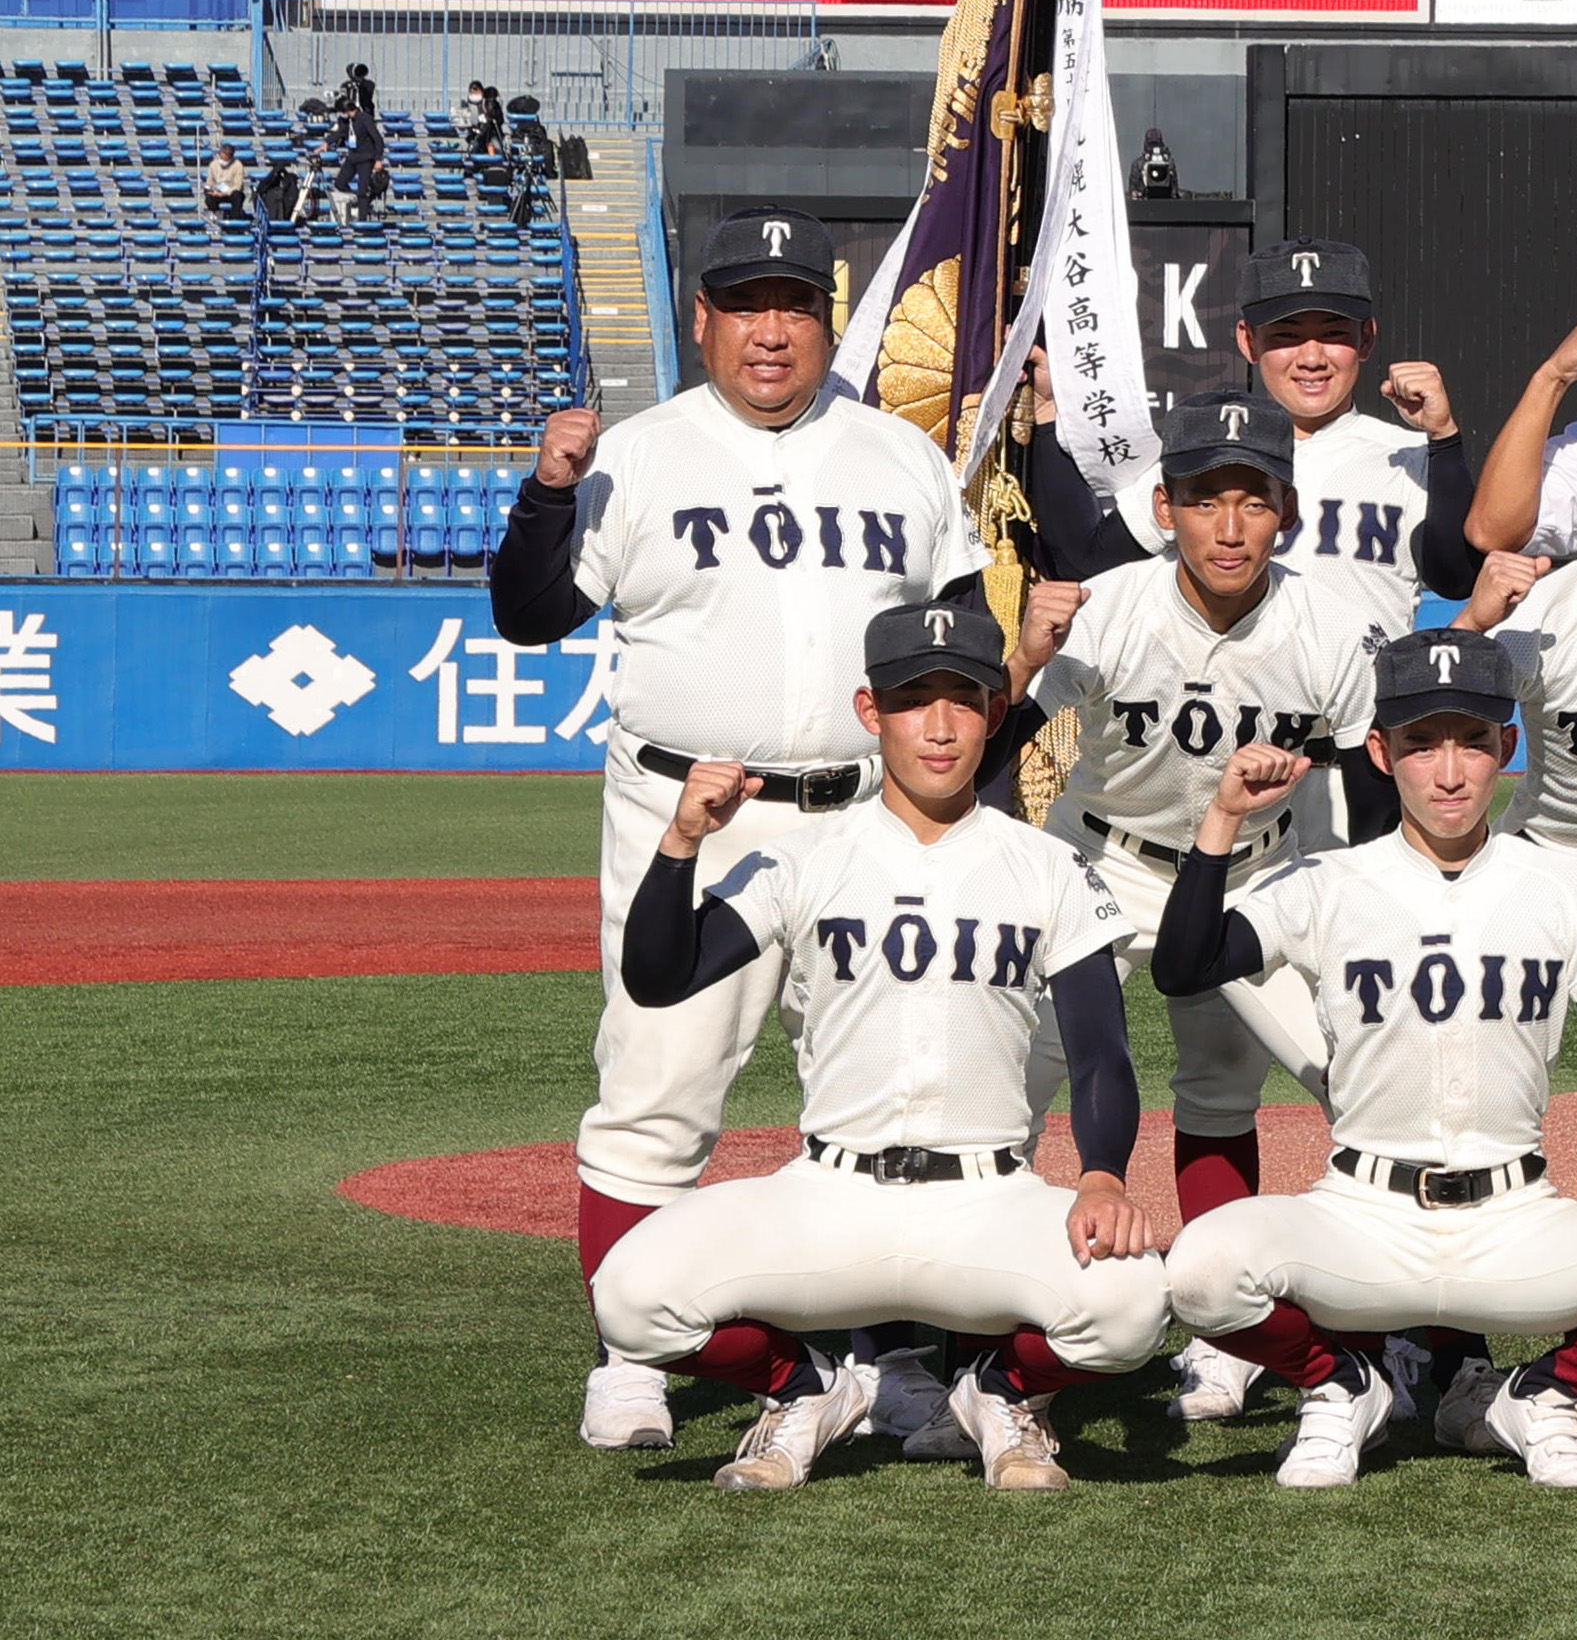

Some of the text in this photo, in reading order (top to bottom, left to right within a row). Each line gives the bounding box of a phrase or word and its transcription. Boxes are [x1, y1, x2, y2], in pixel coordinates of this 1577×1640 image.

[761, 220, 792, 259] T
[1062, 128, 1141, 467] 幌大谷高等学校
